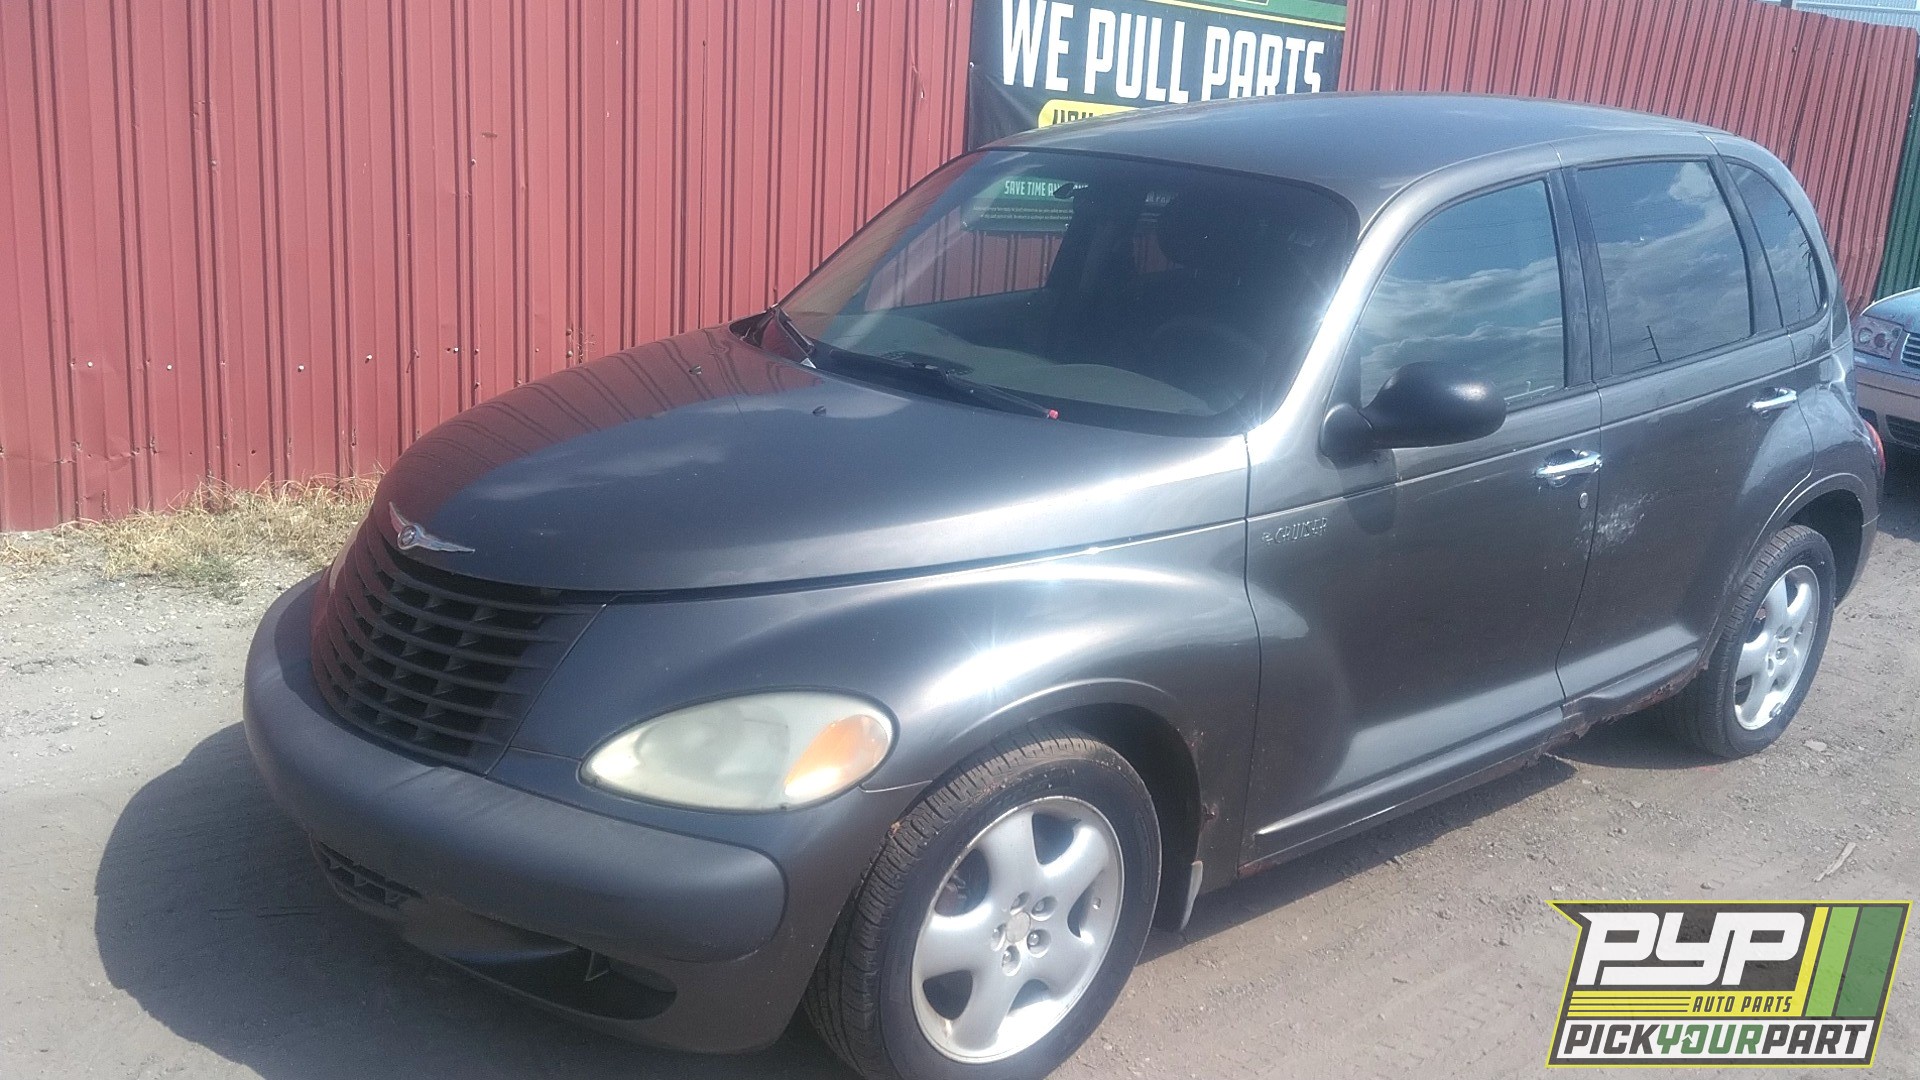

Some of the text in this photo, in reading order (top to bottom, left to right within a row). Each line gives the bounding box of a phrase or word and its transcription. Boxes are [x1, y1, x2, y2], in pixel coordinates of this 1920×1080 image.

[1002, 0, 1325, 104] WE PULL PARTS
[1004, 180, 1025, 195] SAVE
[1027, 181, 1046, 196] TIME
[1275, 517, 1328, 543] CRUISER
